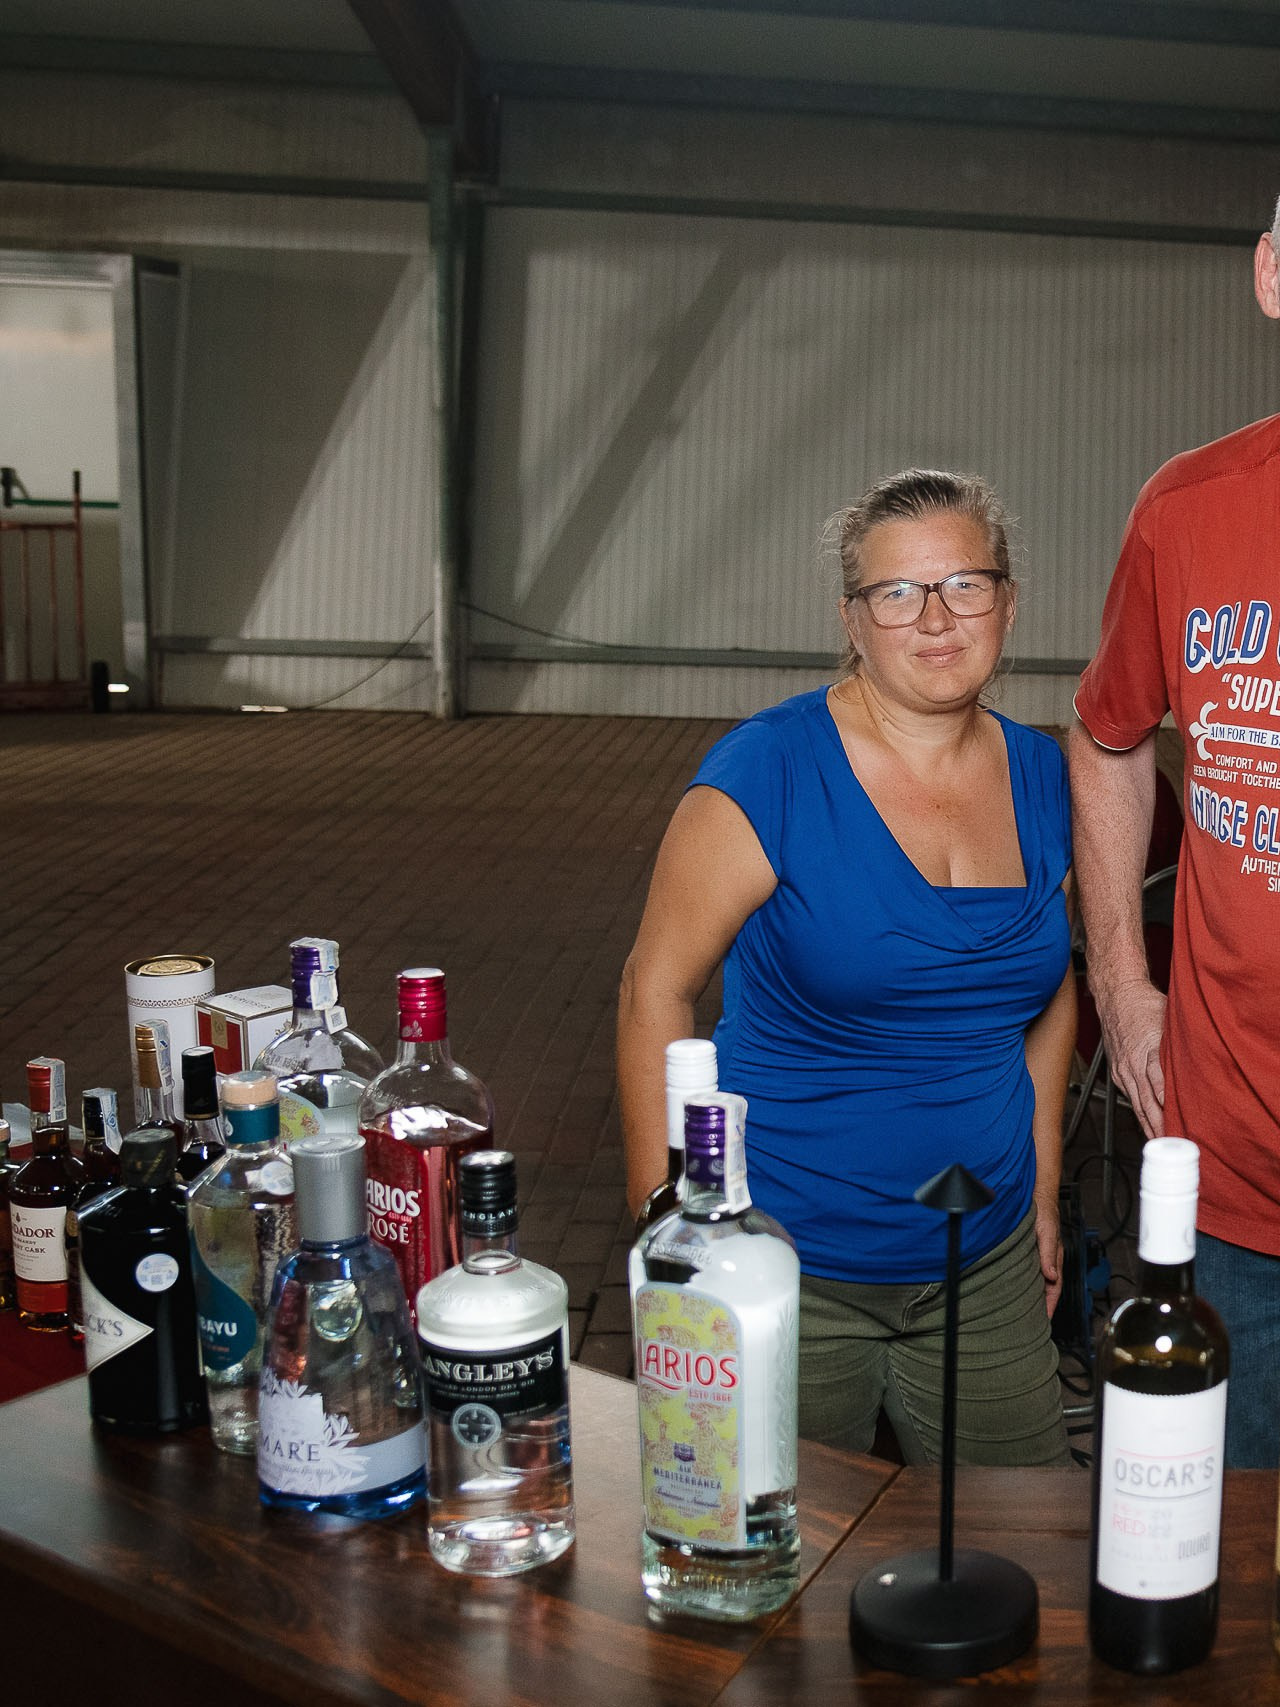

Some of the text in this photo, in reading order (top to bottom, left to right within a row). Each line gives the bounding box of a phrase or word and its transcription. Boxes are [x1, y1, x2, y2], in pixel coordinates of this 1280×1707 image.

[1184, 599, 1272, 674] GOLD
[1209, 725, 1226, 739] AIM
[1228, 727, 1246, 741] FOR
[1248, 730, 1269, 744] THE
[1207, 768, 1239, 784] BROUGHT
[1215, 753, 1254, 770] COMFORT
[1256, 760, 1277, 774] AND
[366, 1178, 421, 1218] ARIOS
[12, 1223, 56, 1239] DADOR
[424, 1345, 554, 1383] ANGLEY'S
[1113, 1455, 1215, 1489] OSCAR'S
